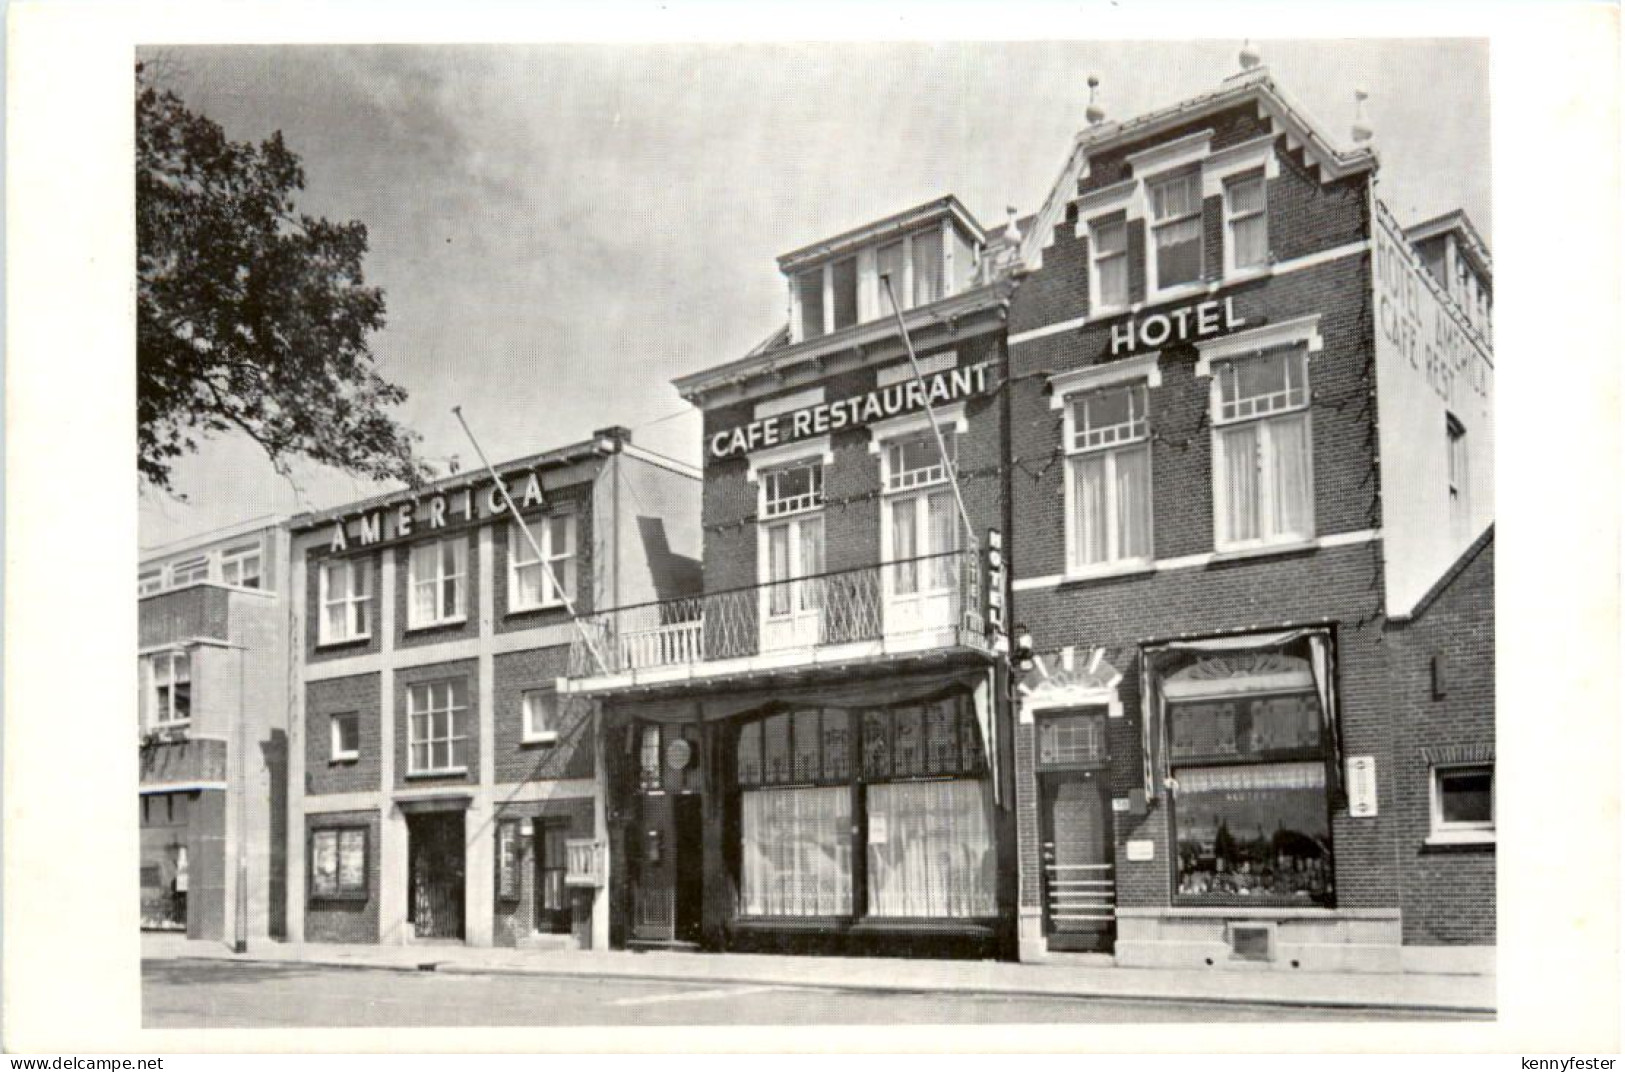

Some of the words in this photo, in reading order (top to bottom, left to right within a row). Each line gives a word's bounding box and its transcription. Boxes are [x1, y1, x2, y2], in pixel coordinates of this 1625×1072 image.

[1111, 297, 1246, 355] HOTEL
[711, 417, 780, 457] CAFE
[793, 362, 989, 438] RESTAURANT
[330, 473, 544, 553] AMERICA
[989, 531, 1003, 629] HOTEL
